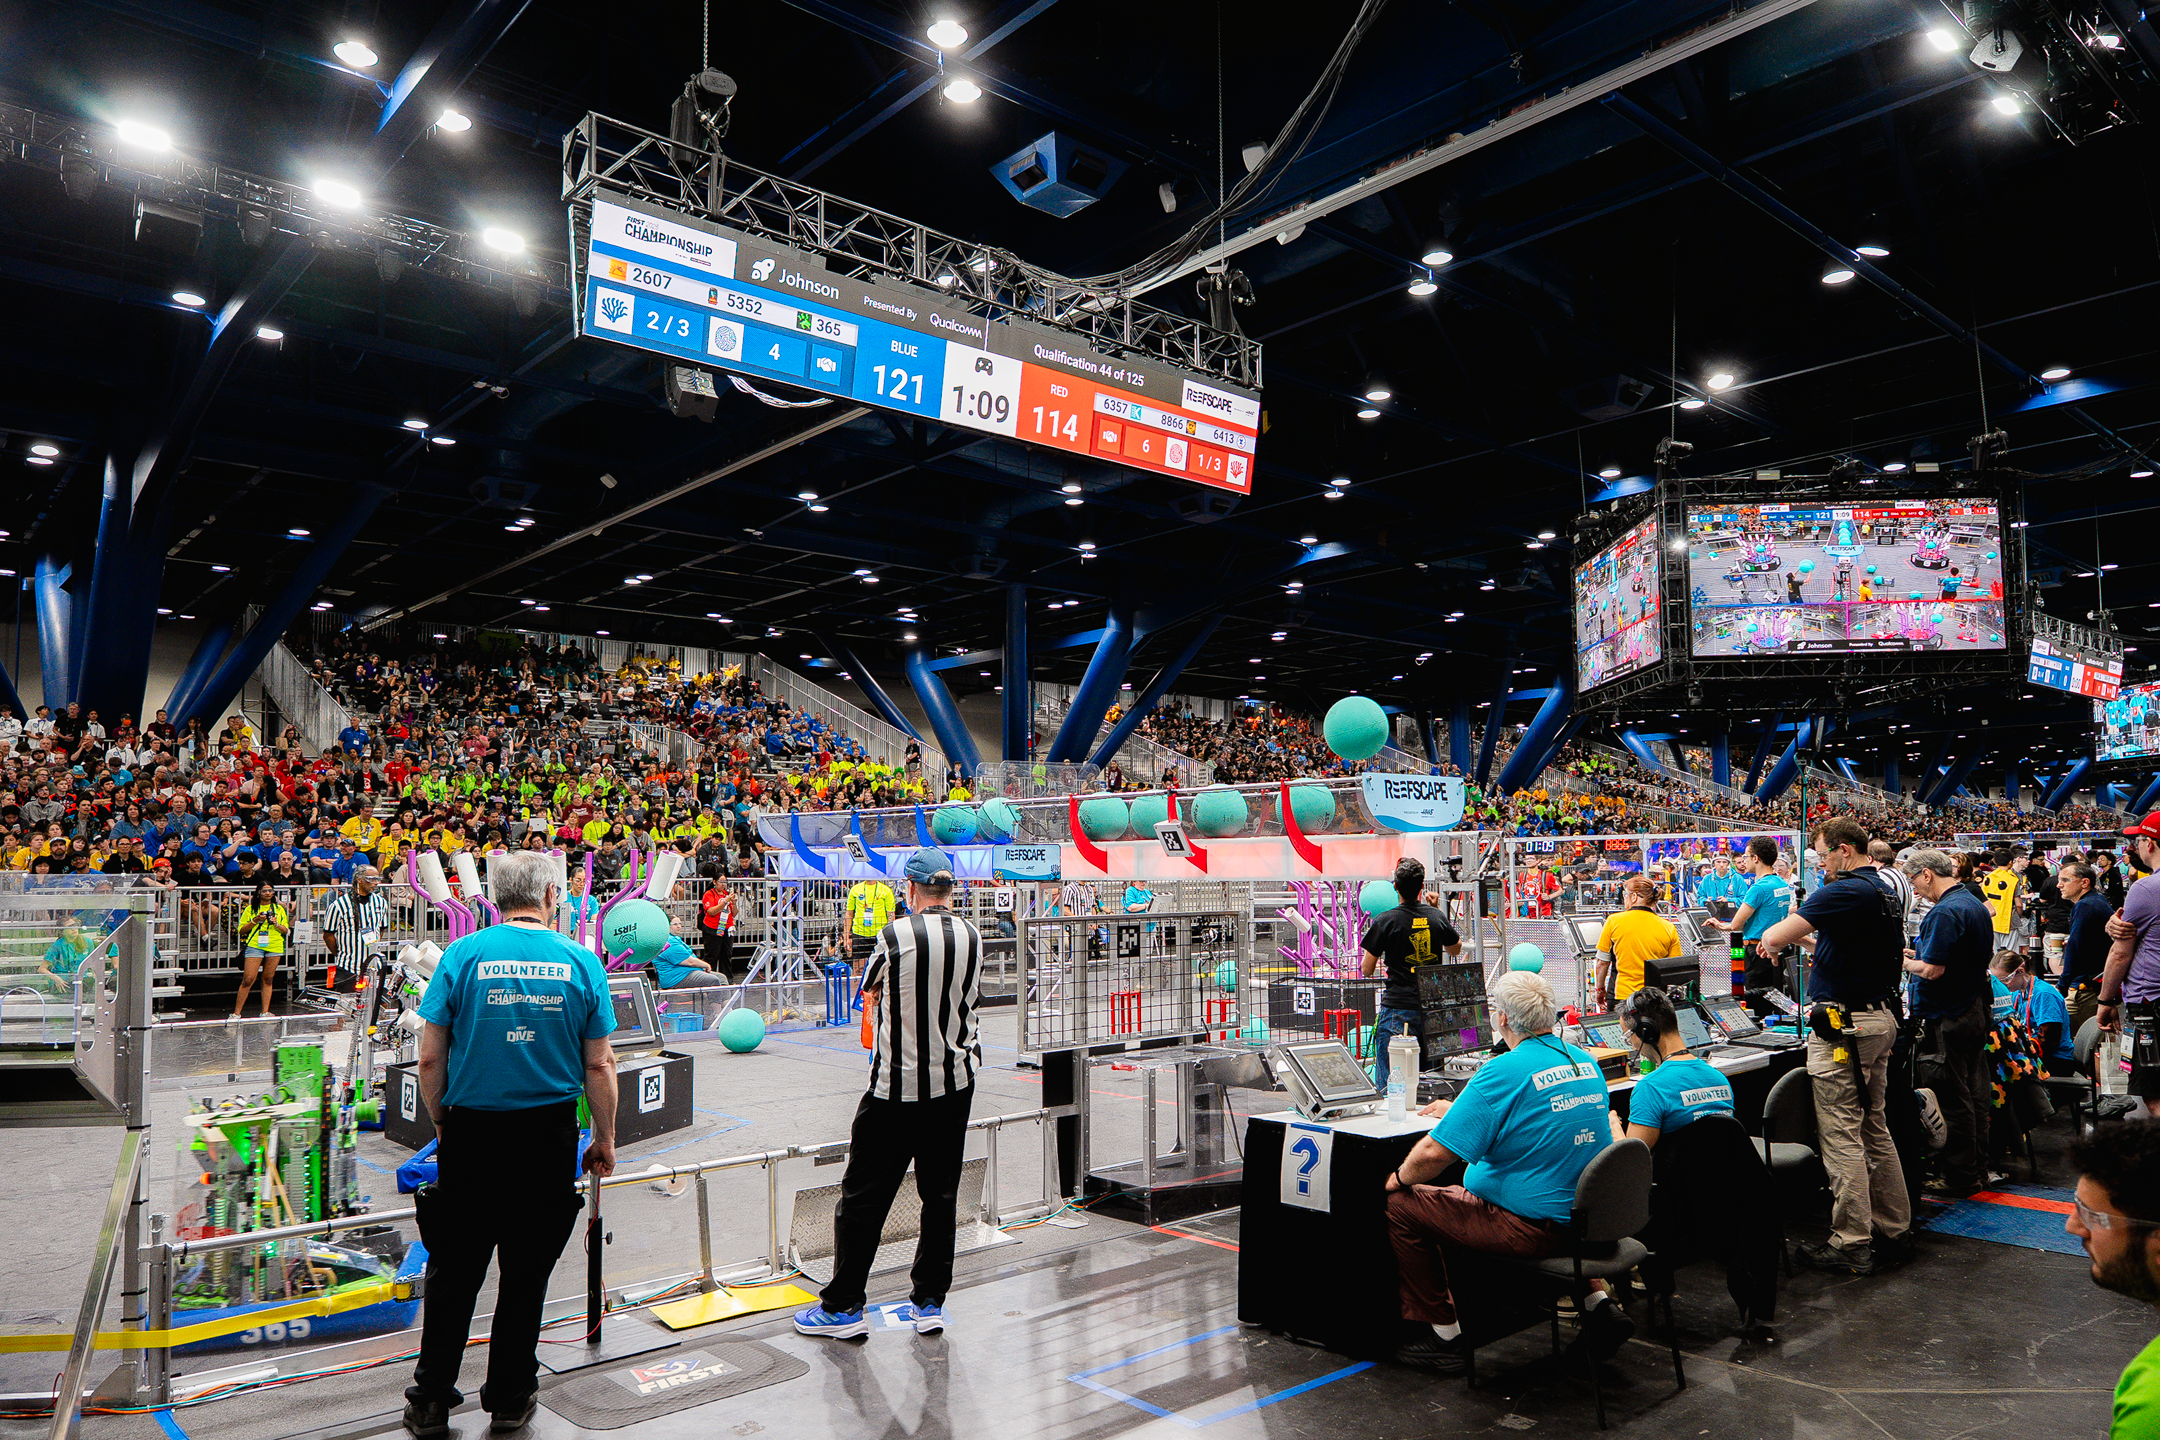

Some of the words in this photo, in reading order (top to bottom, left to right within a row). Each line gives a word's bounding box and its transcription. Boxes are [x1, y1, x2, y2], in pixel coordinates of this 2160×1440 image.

[626, 216, 645, 226] FIRST
[645, 222, 660, 230] 2025
[625, 223, 713, 257] CHAMPIONSHIP
[633, 267, 672, 289] 2607
[778, 269, 840, 300] Johnson
[727, 293, 762, 316] 5352
[863, 295, 902, 318] Presented
[904, 306, 918, 321] By
[646, 310, 659, 330] 2
[663, 314, 672, 334] /
[677, 319, 690, 338] 3
[816, 318, 842, 336] 365
[929, 312, 983, 340] Qualcomm
[768, 344, 780, 360] 4
[890, 340, 918, 358] BLUE
[1034, 344, 1098, 375] Qualification
[1098, 363, 1112, 378] 44
[1114, 368, 1125, 381] of
[1126, 371, 1144, 387] 125
[873, 365, 924, 405] 121
[1050, 383, 1068, 398] RED
[952, 386, 1010, 424] 1:09
[1104, 398, 1128, 414] 6357
[1186, 388, 1232, 412] REEFSCAPE
[1033, 406, 1078, 442] 114
[1160, 414, 1184, 430] 8866
[1213, 429, 1235, 444] 6413
[1142, 439, 1150, 453] 6
[1198, 453, 1204, 467] 1
[1206, 456, 1213, 471] /
[1214, 458, 1221, 472] 3
[1384, 779, 1448, 801] REEFSCAPE
[1006, 849, 1046, 860] REEFSCAPE
[1526, 841, 1554, 852] 01:09
[613, 922, 638, 936] FIRST
[483, 964, 565, 978] VOLUNTEER
[306, 998, 334, 1008] COMCAST
[487, 994, 564, 1006] CHAMPIONSHIP
[506, 1030, 536, 1042] DIVE
[1551, 1092, 1604, 1112] CHAMPIONSHIP
[1685, 1089, 1730, 1102] VOLUNTEER
[1574, 1132, 1596, 1146] DIVE
[239, 1318, 311, 1344] 365
